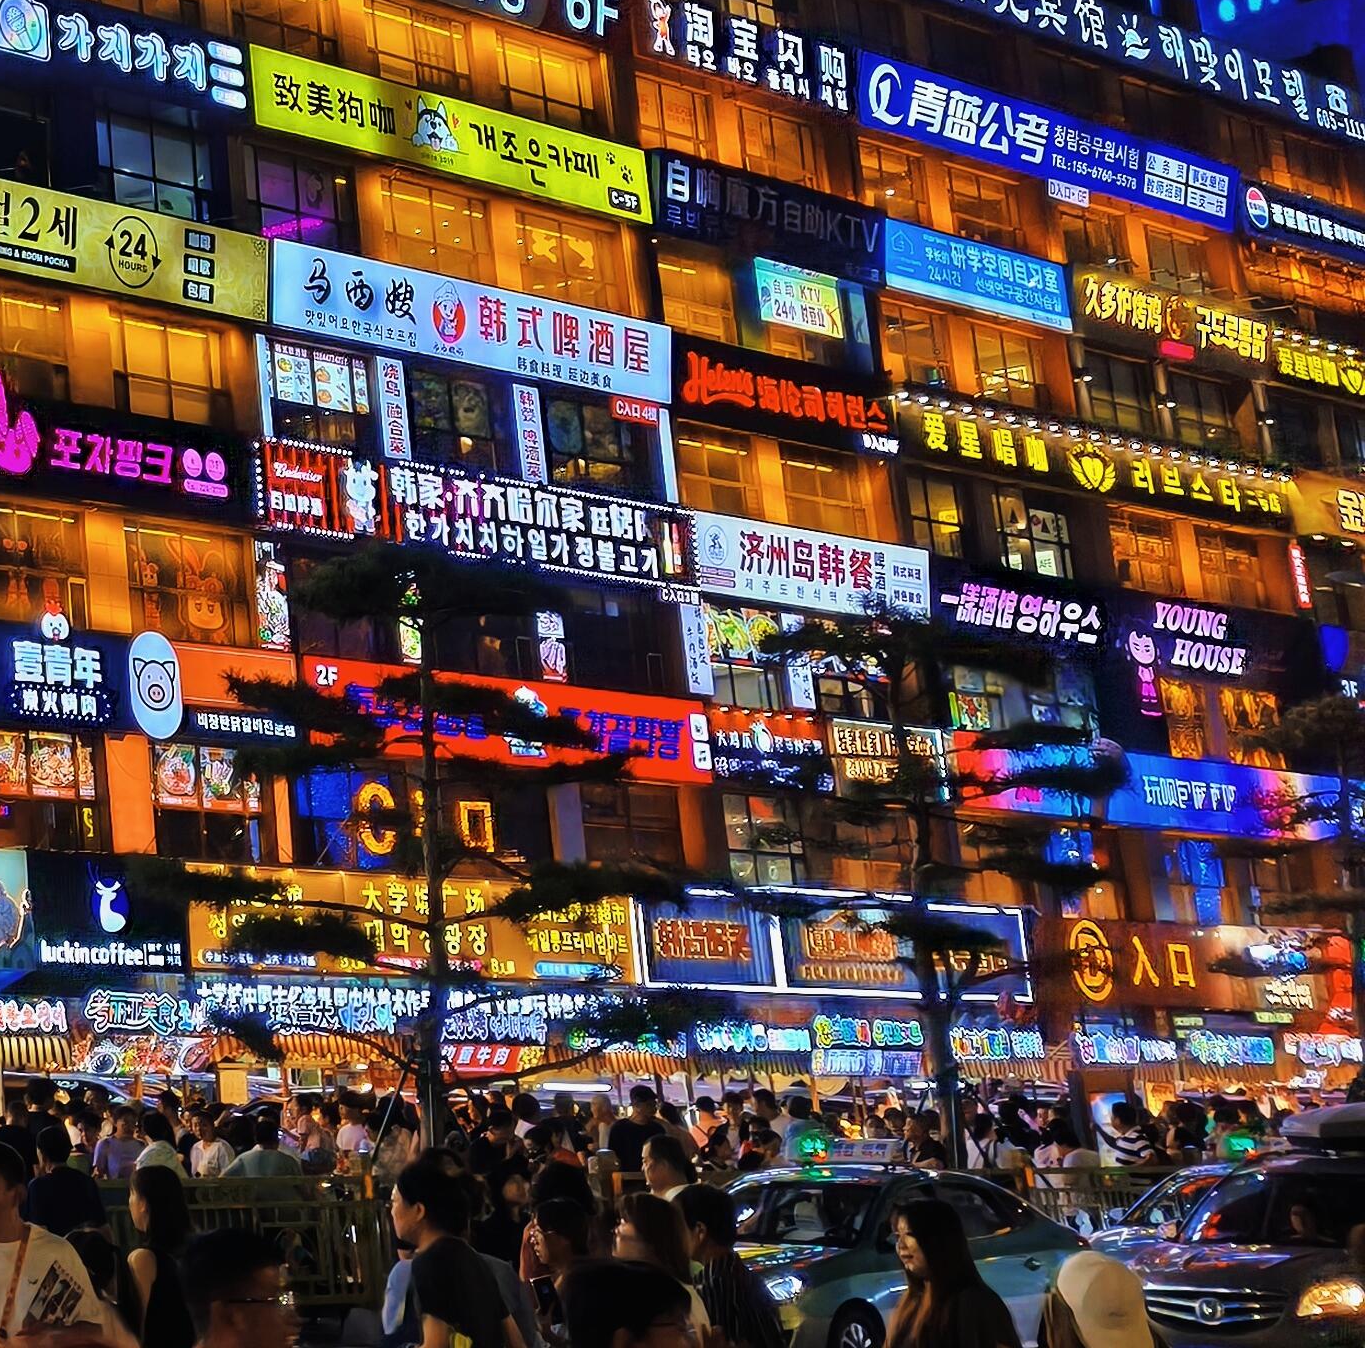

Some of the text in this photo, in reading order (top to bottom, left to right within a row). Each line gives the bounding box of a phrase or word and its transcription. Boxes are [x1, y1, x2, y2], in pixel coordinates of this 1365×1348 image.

[58, 13, 210, 93] 가지가지
[684, 2, 848, 89] 淘宝闪购
[1160, 28, 1309, 121] 해맞이모텔
[273, 72, 397, 135] 致美狗咖
[907, 80, 1050, 164] 青蓝公考
[118, 230, 147, 260] 24
[479, 295, 651, 374] 韩式啤酒屋
[51, 428, 174, 484] 포차핑크
[923, 412, 1242, 513] 爱星唱咖 러브스타
[739, 531, 874, 593] 济州岛韩餐
[1154, 601, 1228, 639] YOUNG
[315, 665, 338, 686] 2F
[1171, 638, 1247, 676] HOUSE
